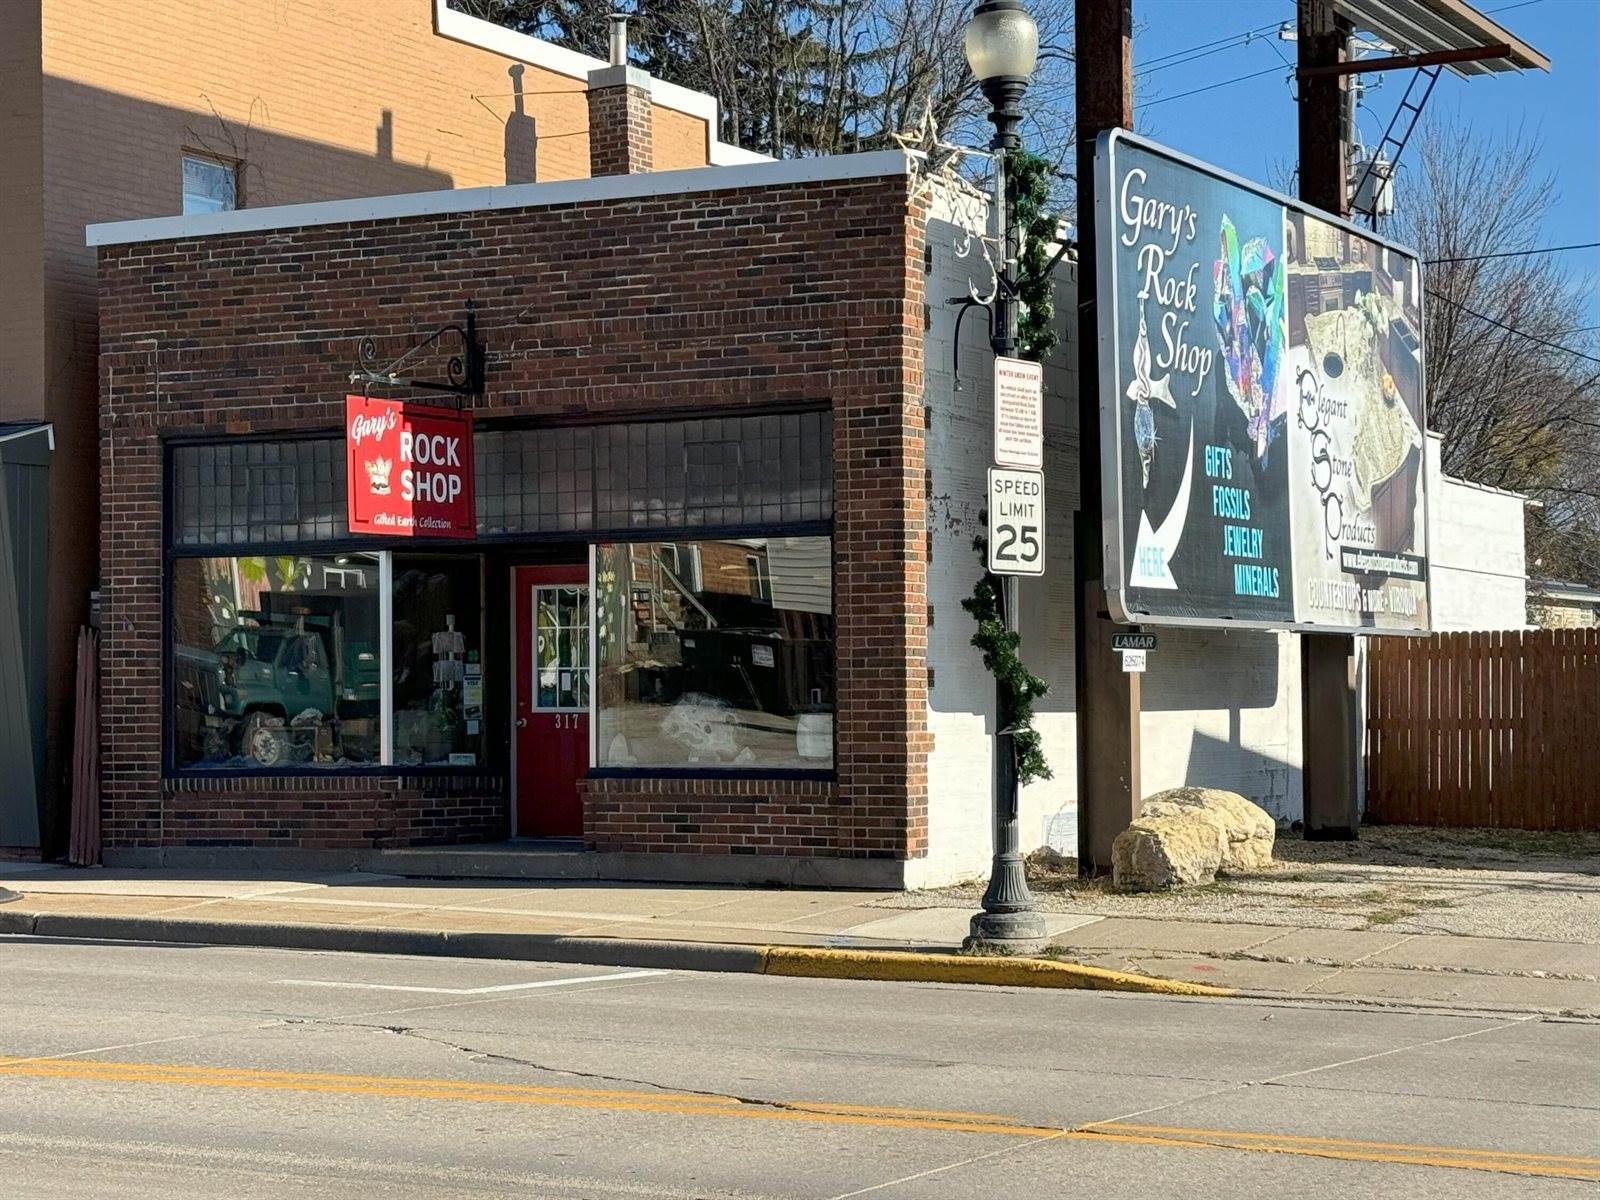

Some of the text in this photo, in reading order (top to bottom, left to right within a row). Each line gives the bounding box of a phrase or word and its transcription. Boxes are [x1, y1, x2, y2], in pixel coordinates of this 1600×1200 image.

[1121, 168, 1197, 256] Gary's
[1137, 244, 1199, 312] Rock
[1156, 311, 1212, 397] Shop
[1296, 366, 1348, 432] Elegant
[352, 407, 397, 446] Gary's
[400, 431, 461, 467] ROCK
[1205, 444, 1232, 480] GIFTS
[1311, 429, 1353, 492] Stone
[400, 469, 462, 504] SHOP
[995, 479, 1040, 496] SPEED
[1212, 485, 1251, 521] FOSSILS
[373, 512, 452, 529] Gifted Earth Collection
[1000, 501, 1035, 518] LIMIT
[1321, 492, 1376, 560] Products
[996, 524, 1040, 562] 25
[1223, 525, 1263, 560] JEWELRY
[1139, 546, 1166, 577] HERE
[1233, 563, 1280, 598] MINERALS
[1114, 636, 1154, 648] LAMAR
[555, 713, 579, 729] 317
